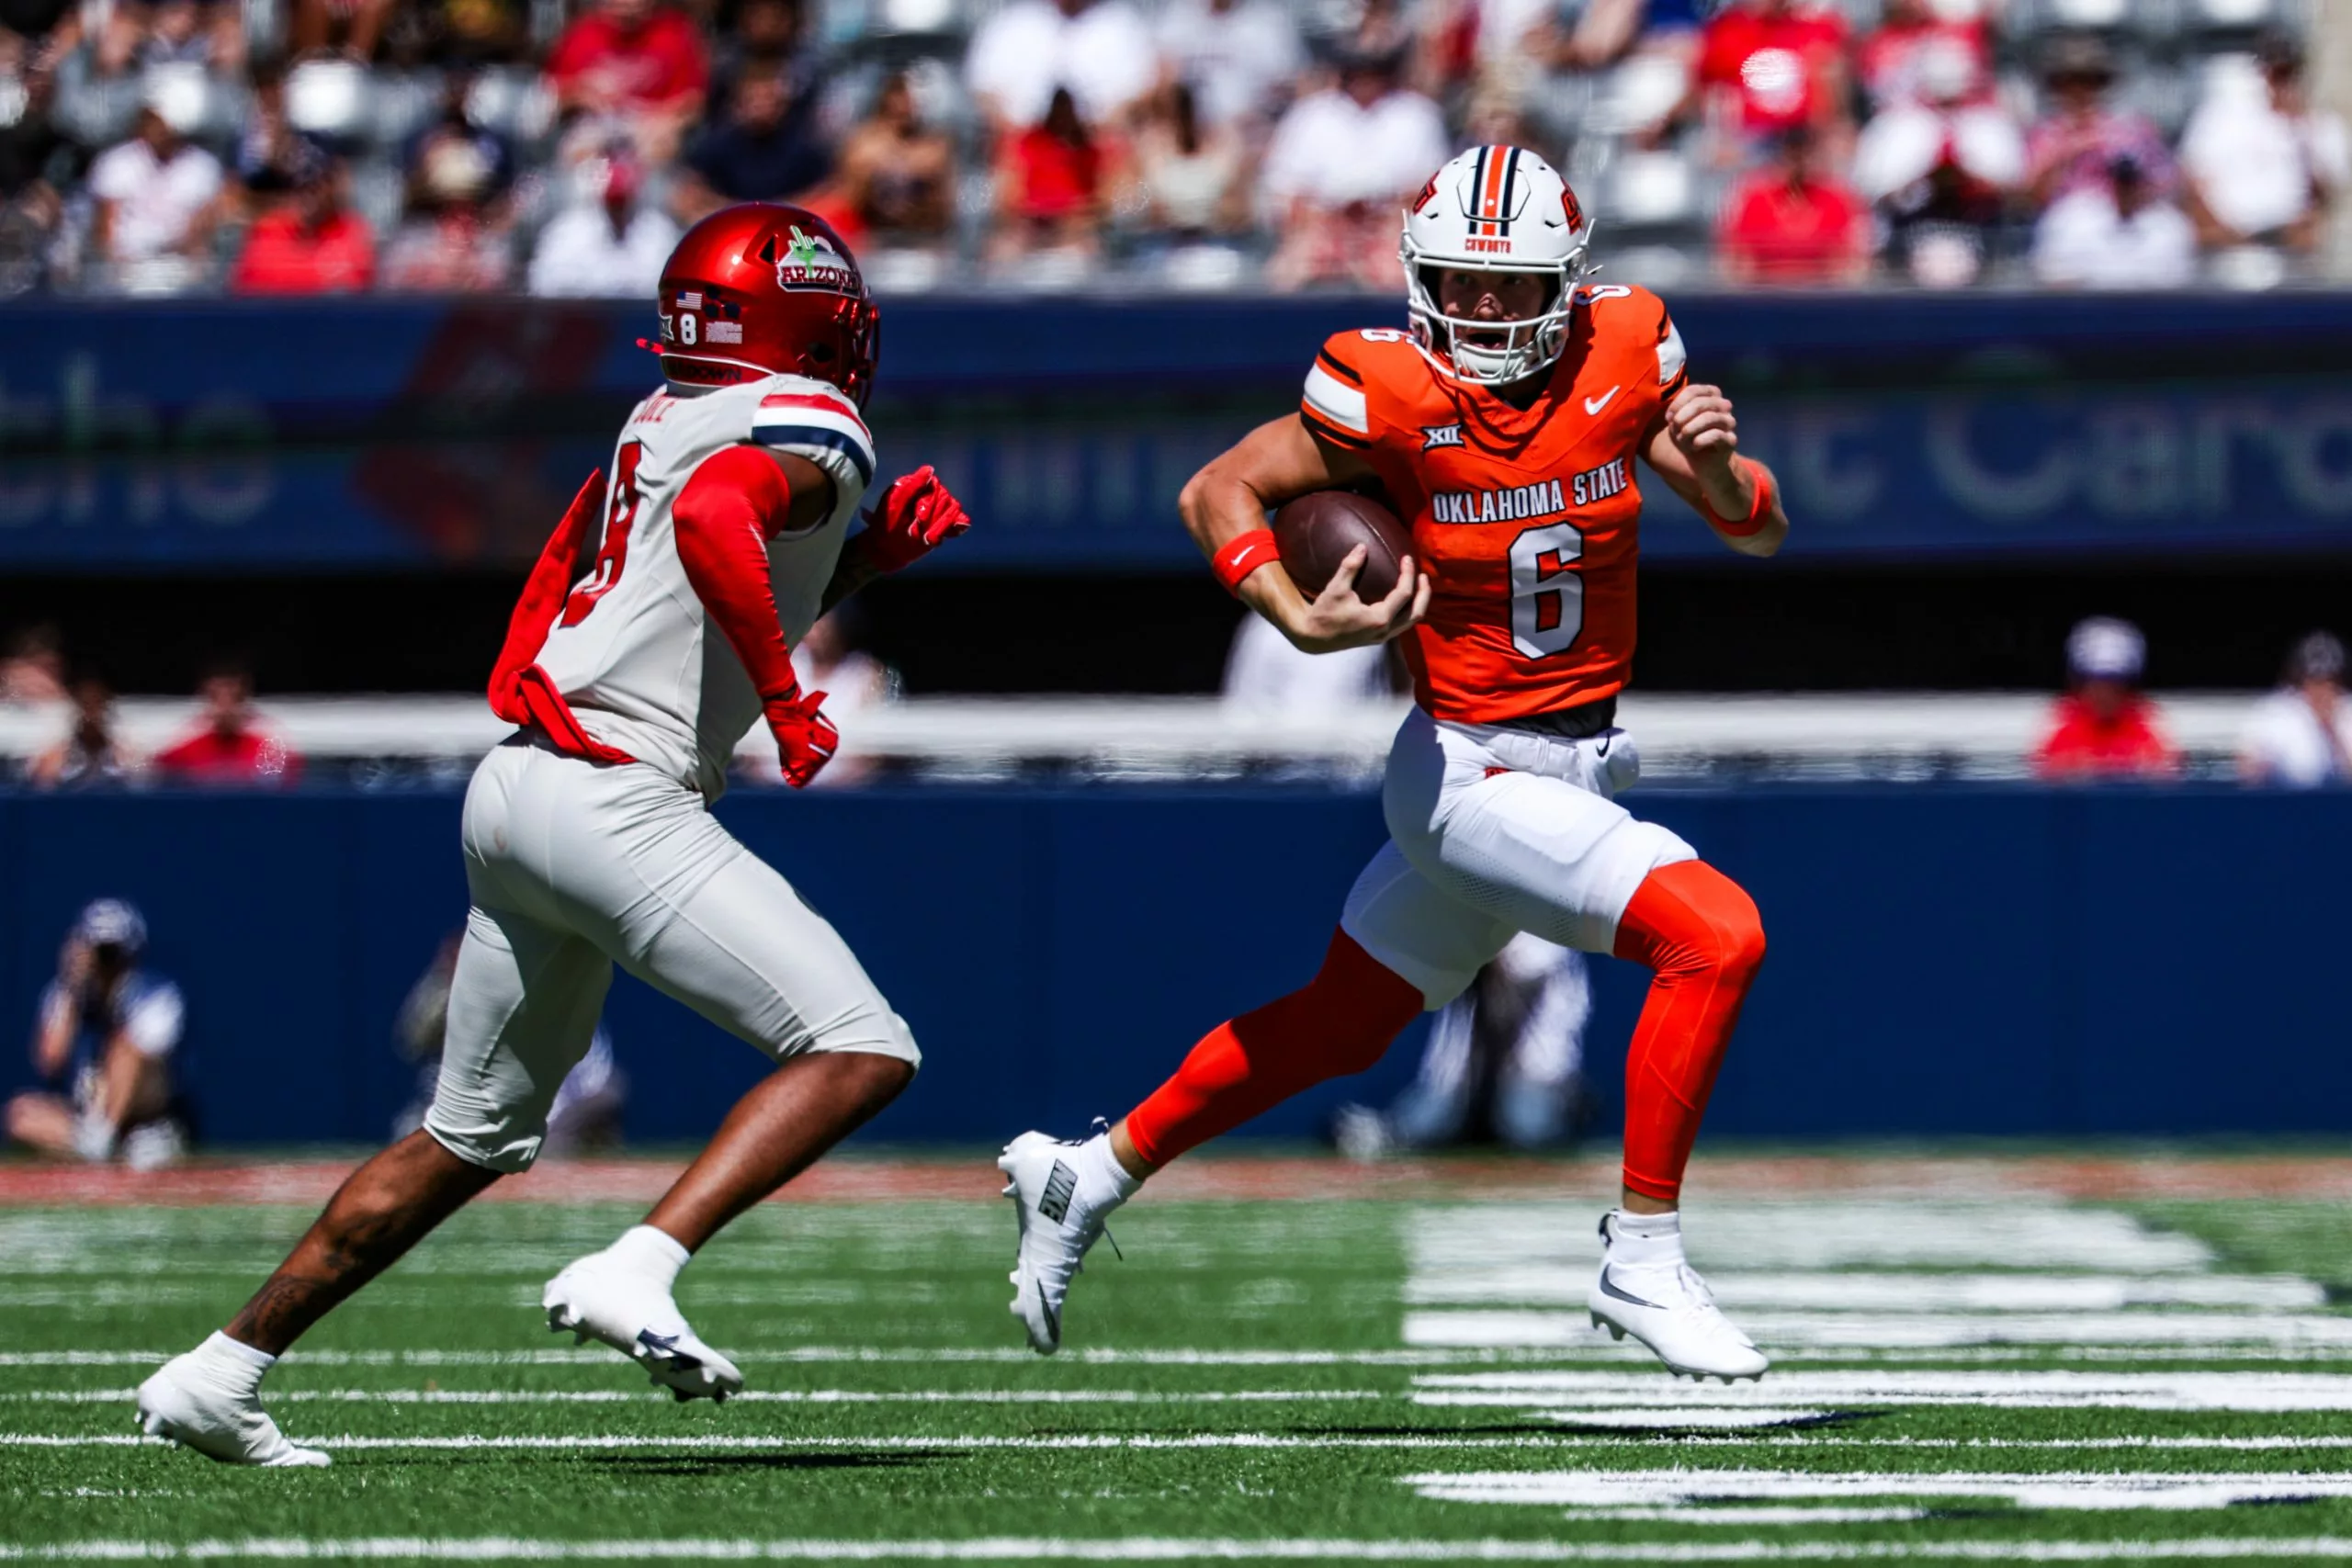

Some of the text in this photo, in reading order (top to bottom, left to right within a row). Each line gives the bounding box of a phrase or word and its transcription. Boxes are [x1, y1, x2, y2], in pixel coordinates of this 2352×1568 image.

[1464, 238, 1511, 254] COWBOYS
[782, 265, 861, 289] ARIZONA
[681, 313, 697, 345] 8
[1422, 423, 1464, 449] XII
[1432, 457, 1629, 524] OKLAHOMA STATE
[558, 441, 642, 630] 8
[1509, 520, 1585, 660] 6
[1037, 1157, 1079, 1226] NIKE
